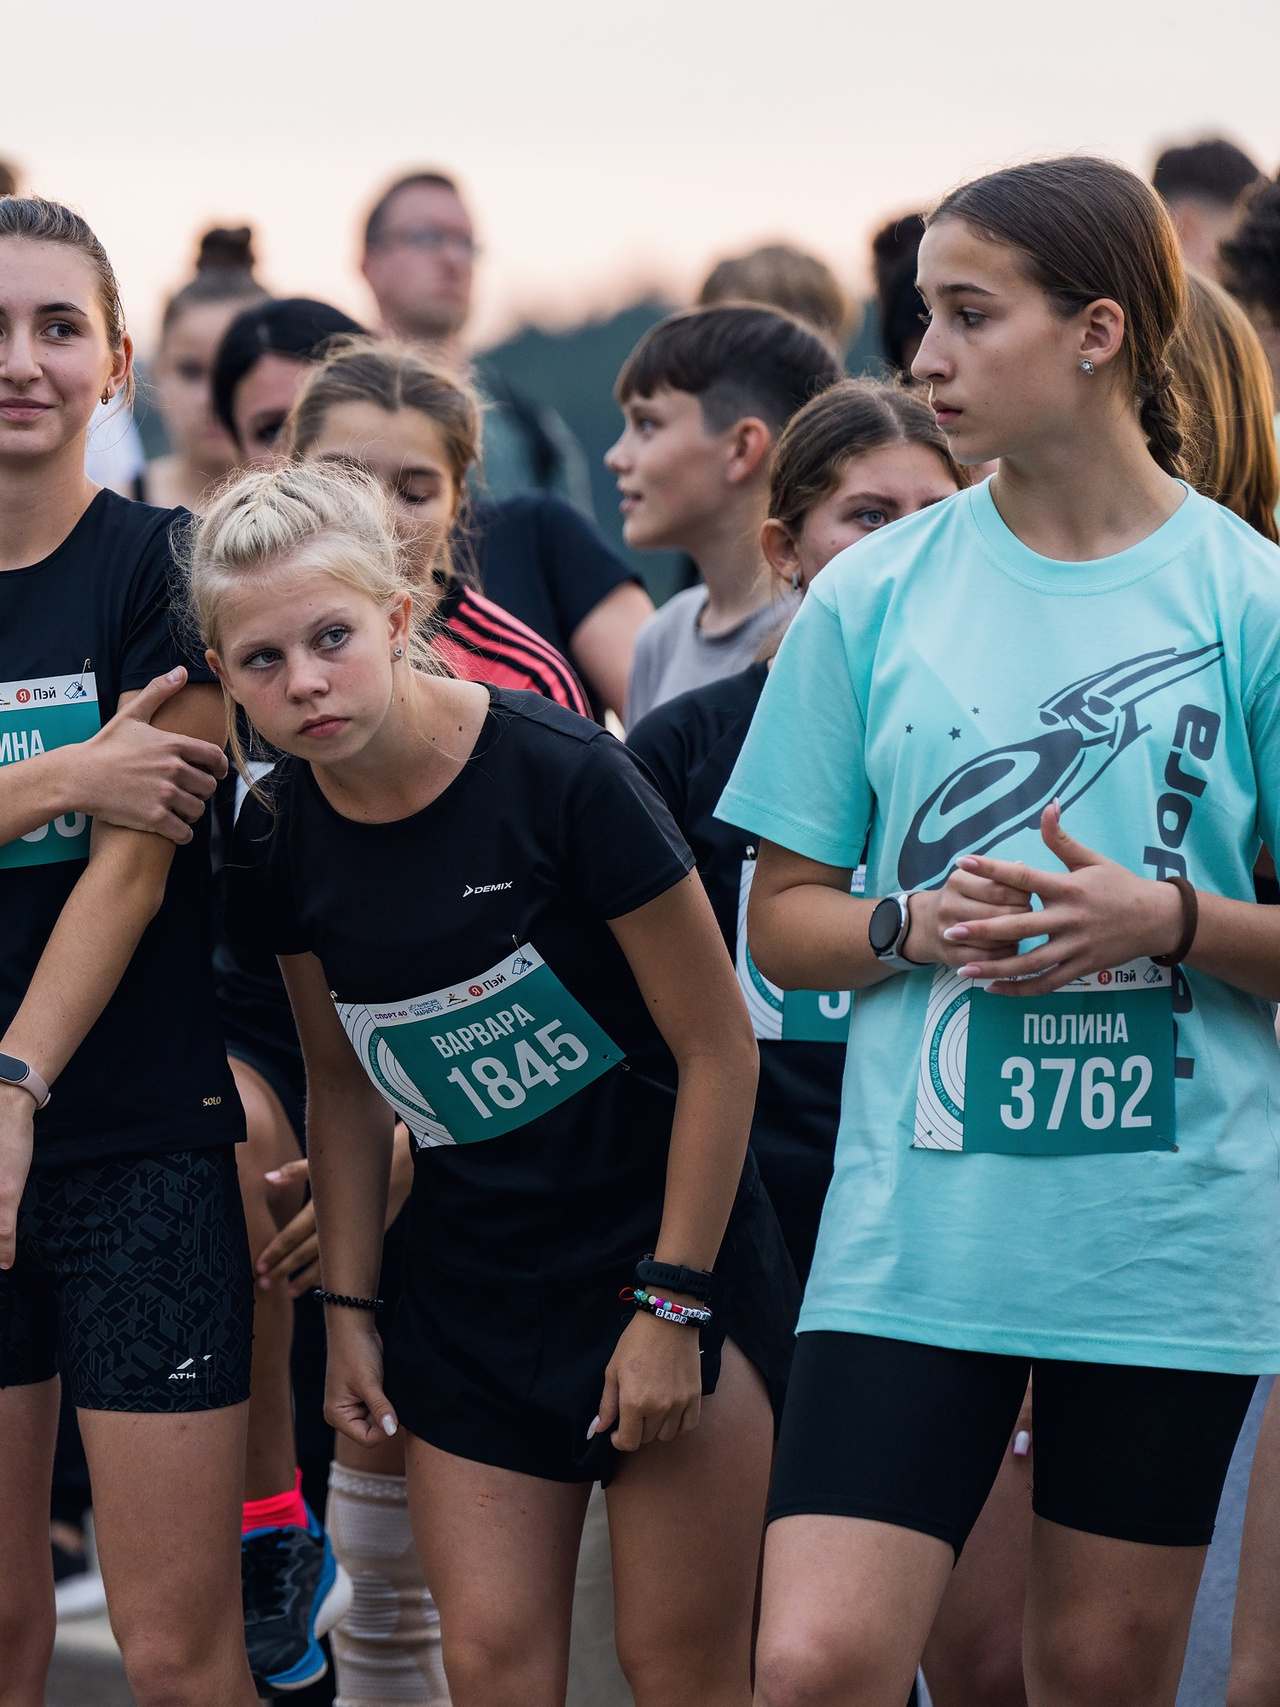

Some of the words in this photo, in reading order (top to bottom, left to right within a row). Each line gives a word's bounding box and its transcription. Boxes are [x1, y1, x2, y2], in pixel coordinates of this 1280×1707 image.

[33, 686, 57, 701] Пэй
[474, 881, 513, 894] DEMIX
[482, 973, 507, 992] Пэй
[1115, 970, 1137, 983] Пэй
[374, 1011, 397, 1020] СПОРТ
[398, 1009, 408, 1018] 40
[430, 1003, 536, 1059] ВАРВАРА
[1023, 1012, 1129, 1045] ПОЛИНА
[446, 1018, 589, 1120] 1845
[931, 1061, 943, 1094] 2010-2011
[202, 1096, 222, 1106] SOLO
[1000, 1054, 1153, 1130] 3762
